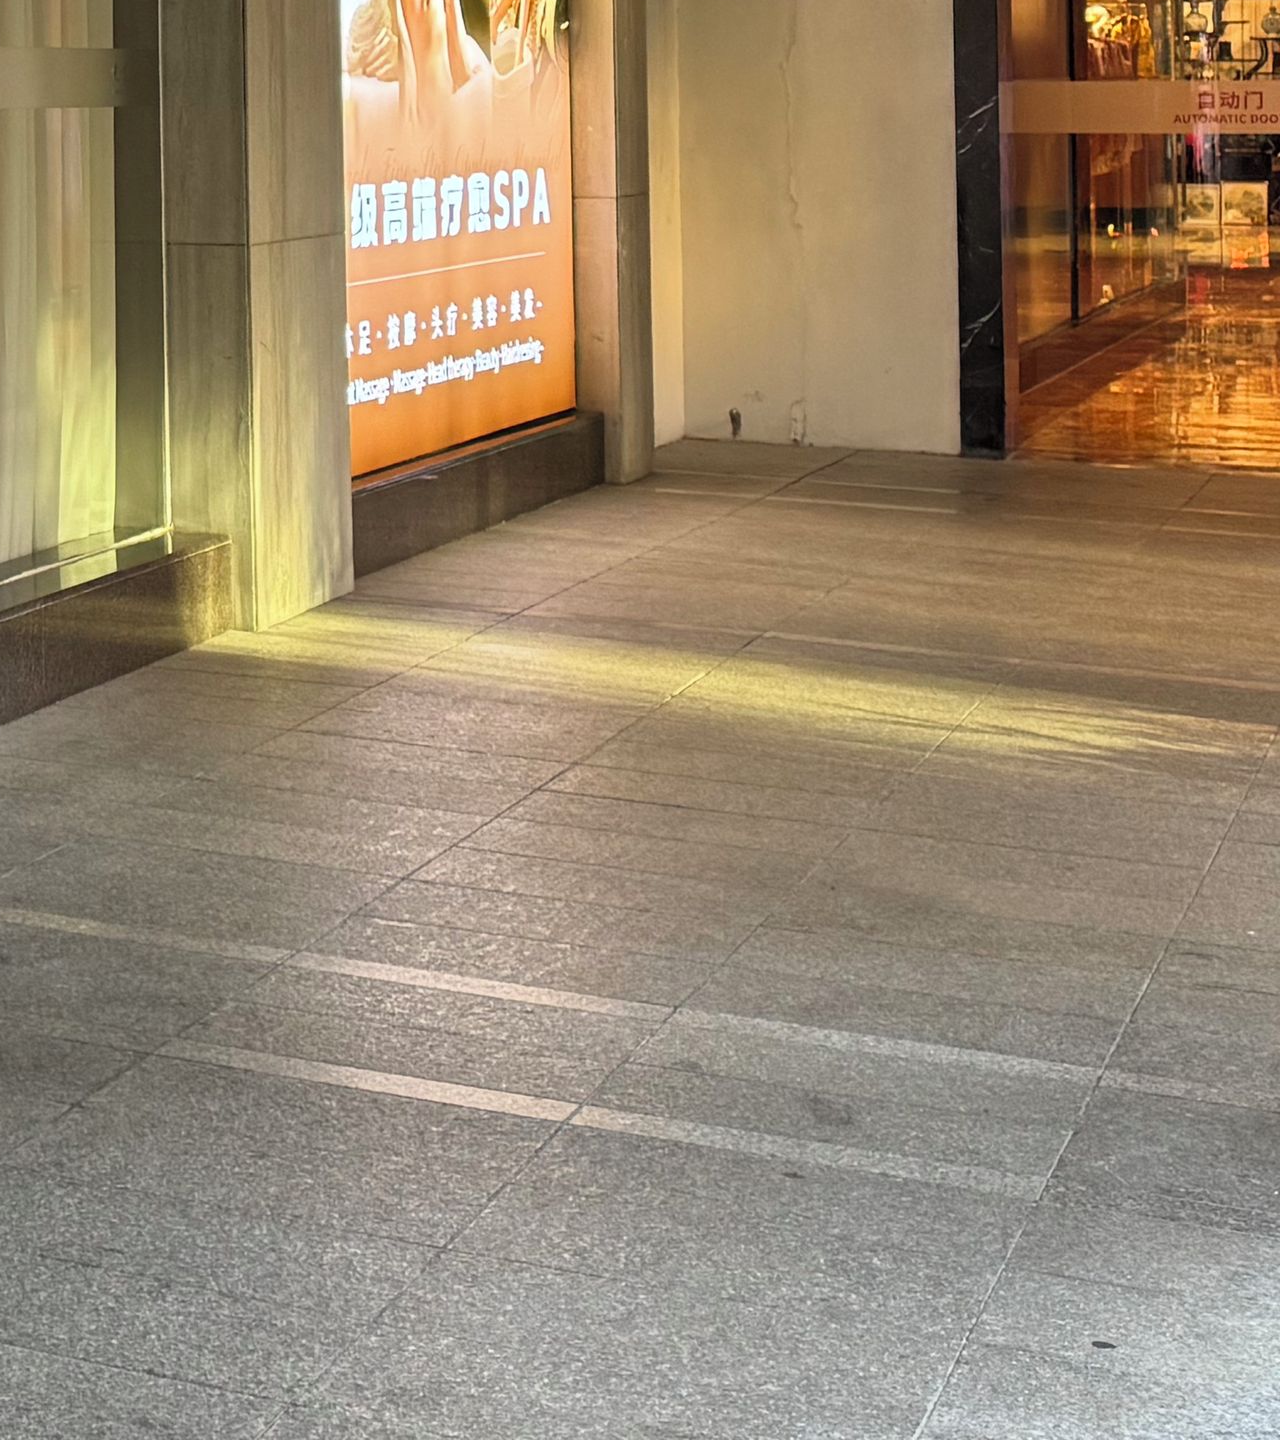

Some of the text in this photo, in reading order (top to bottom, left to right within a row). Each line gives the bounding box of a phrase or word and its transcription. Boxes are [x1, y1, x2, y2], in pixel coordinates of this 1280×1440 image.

[1198, 90, 1264, 110] 自动门
[1173, 113, 1280, 125] AUTOMATIC DOO
